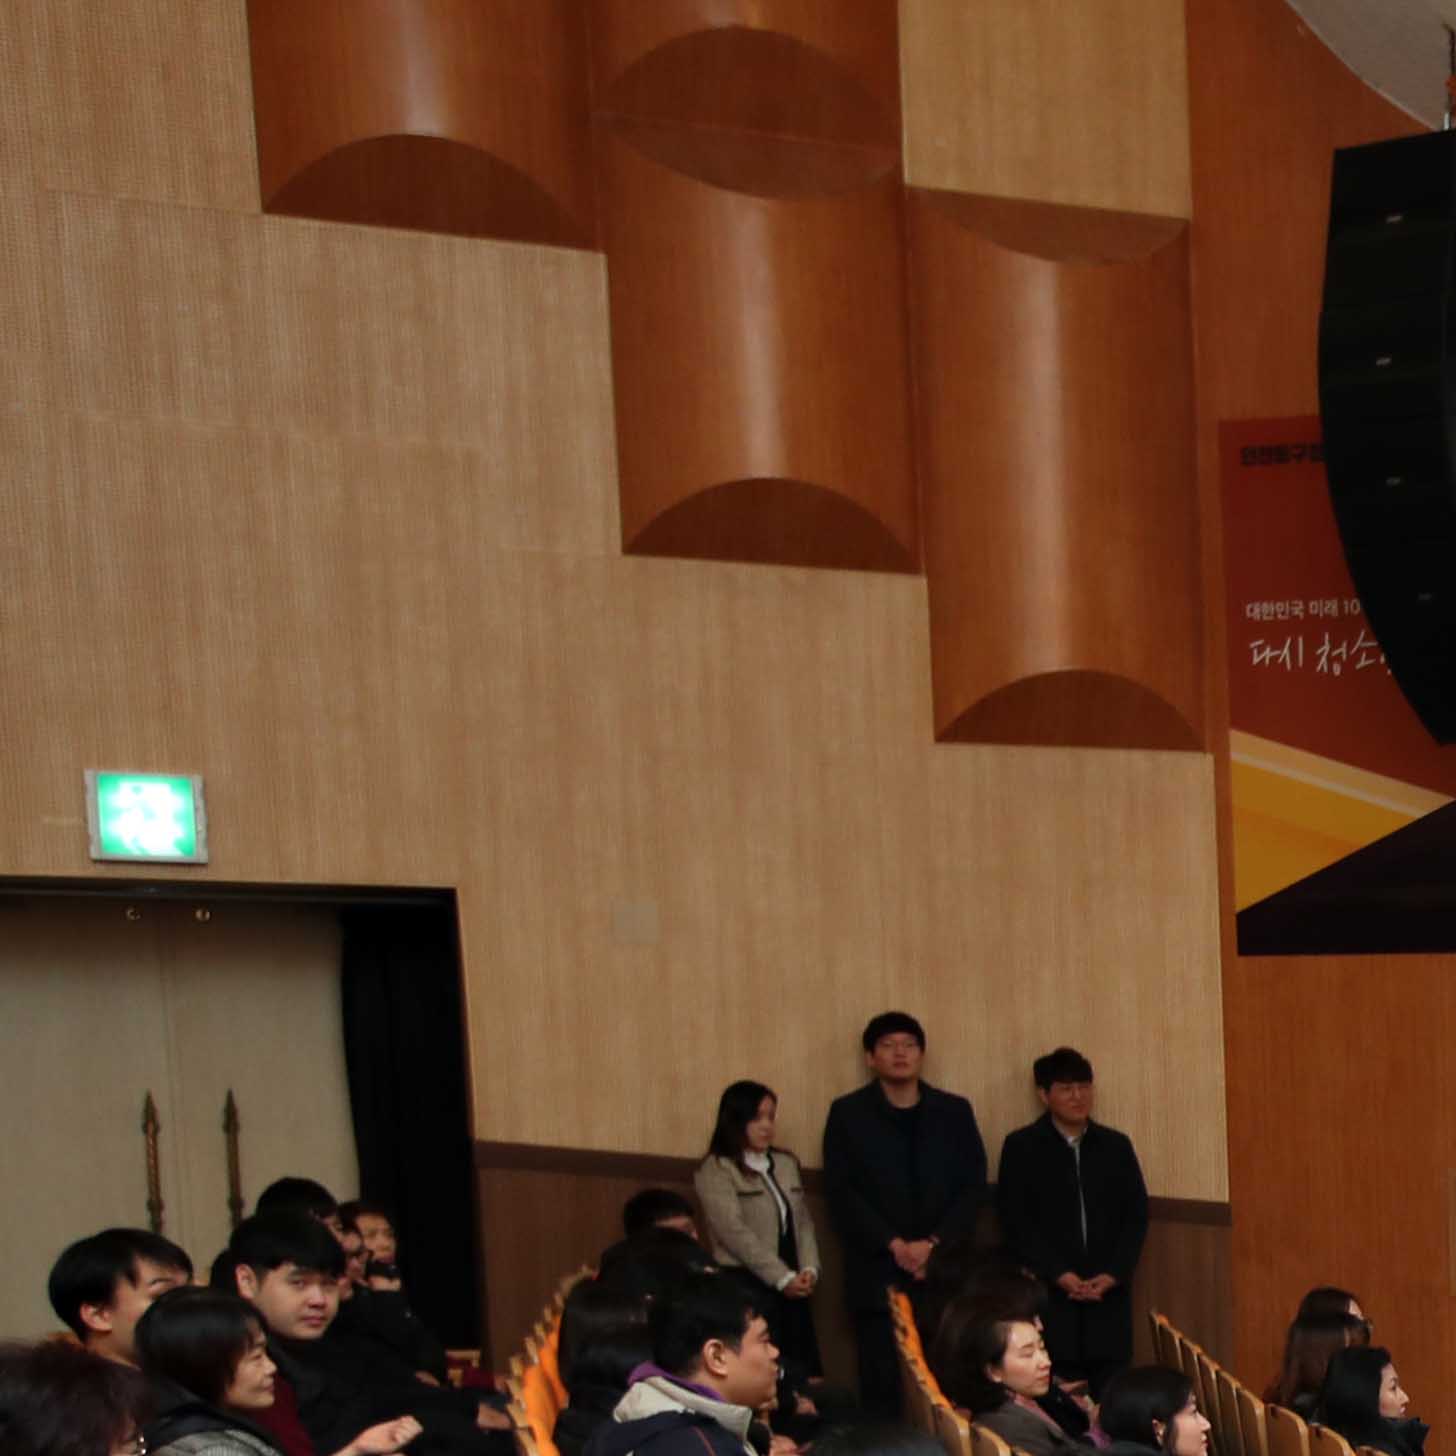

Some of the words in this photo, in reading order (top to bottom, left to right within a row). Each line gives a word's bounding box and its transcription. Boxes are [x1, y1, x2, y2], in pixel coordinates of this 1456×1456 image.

[1246, 600, 1305, 620] 대한민국
[1309, 599, 1339, 617] 미래
[1250, 636, 1304, 671] 다시
[1316, 629, 1392, 676] 청소
